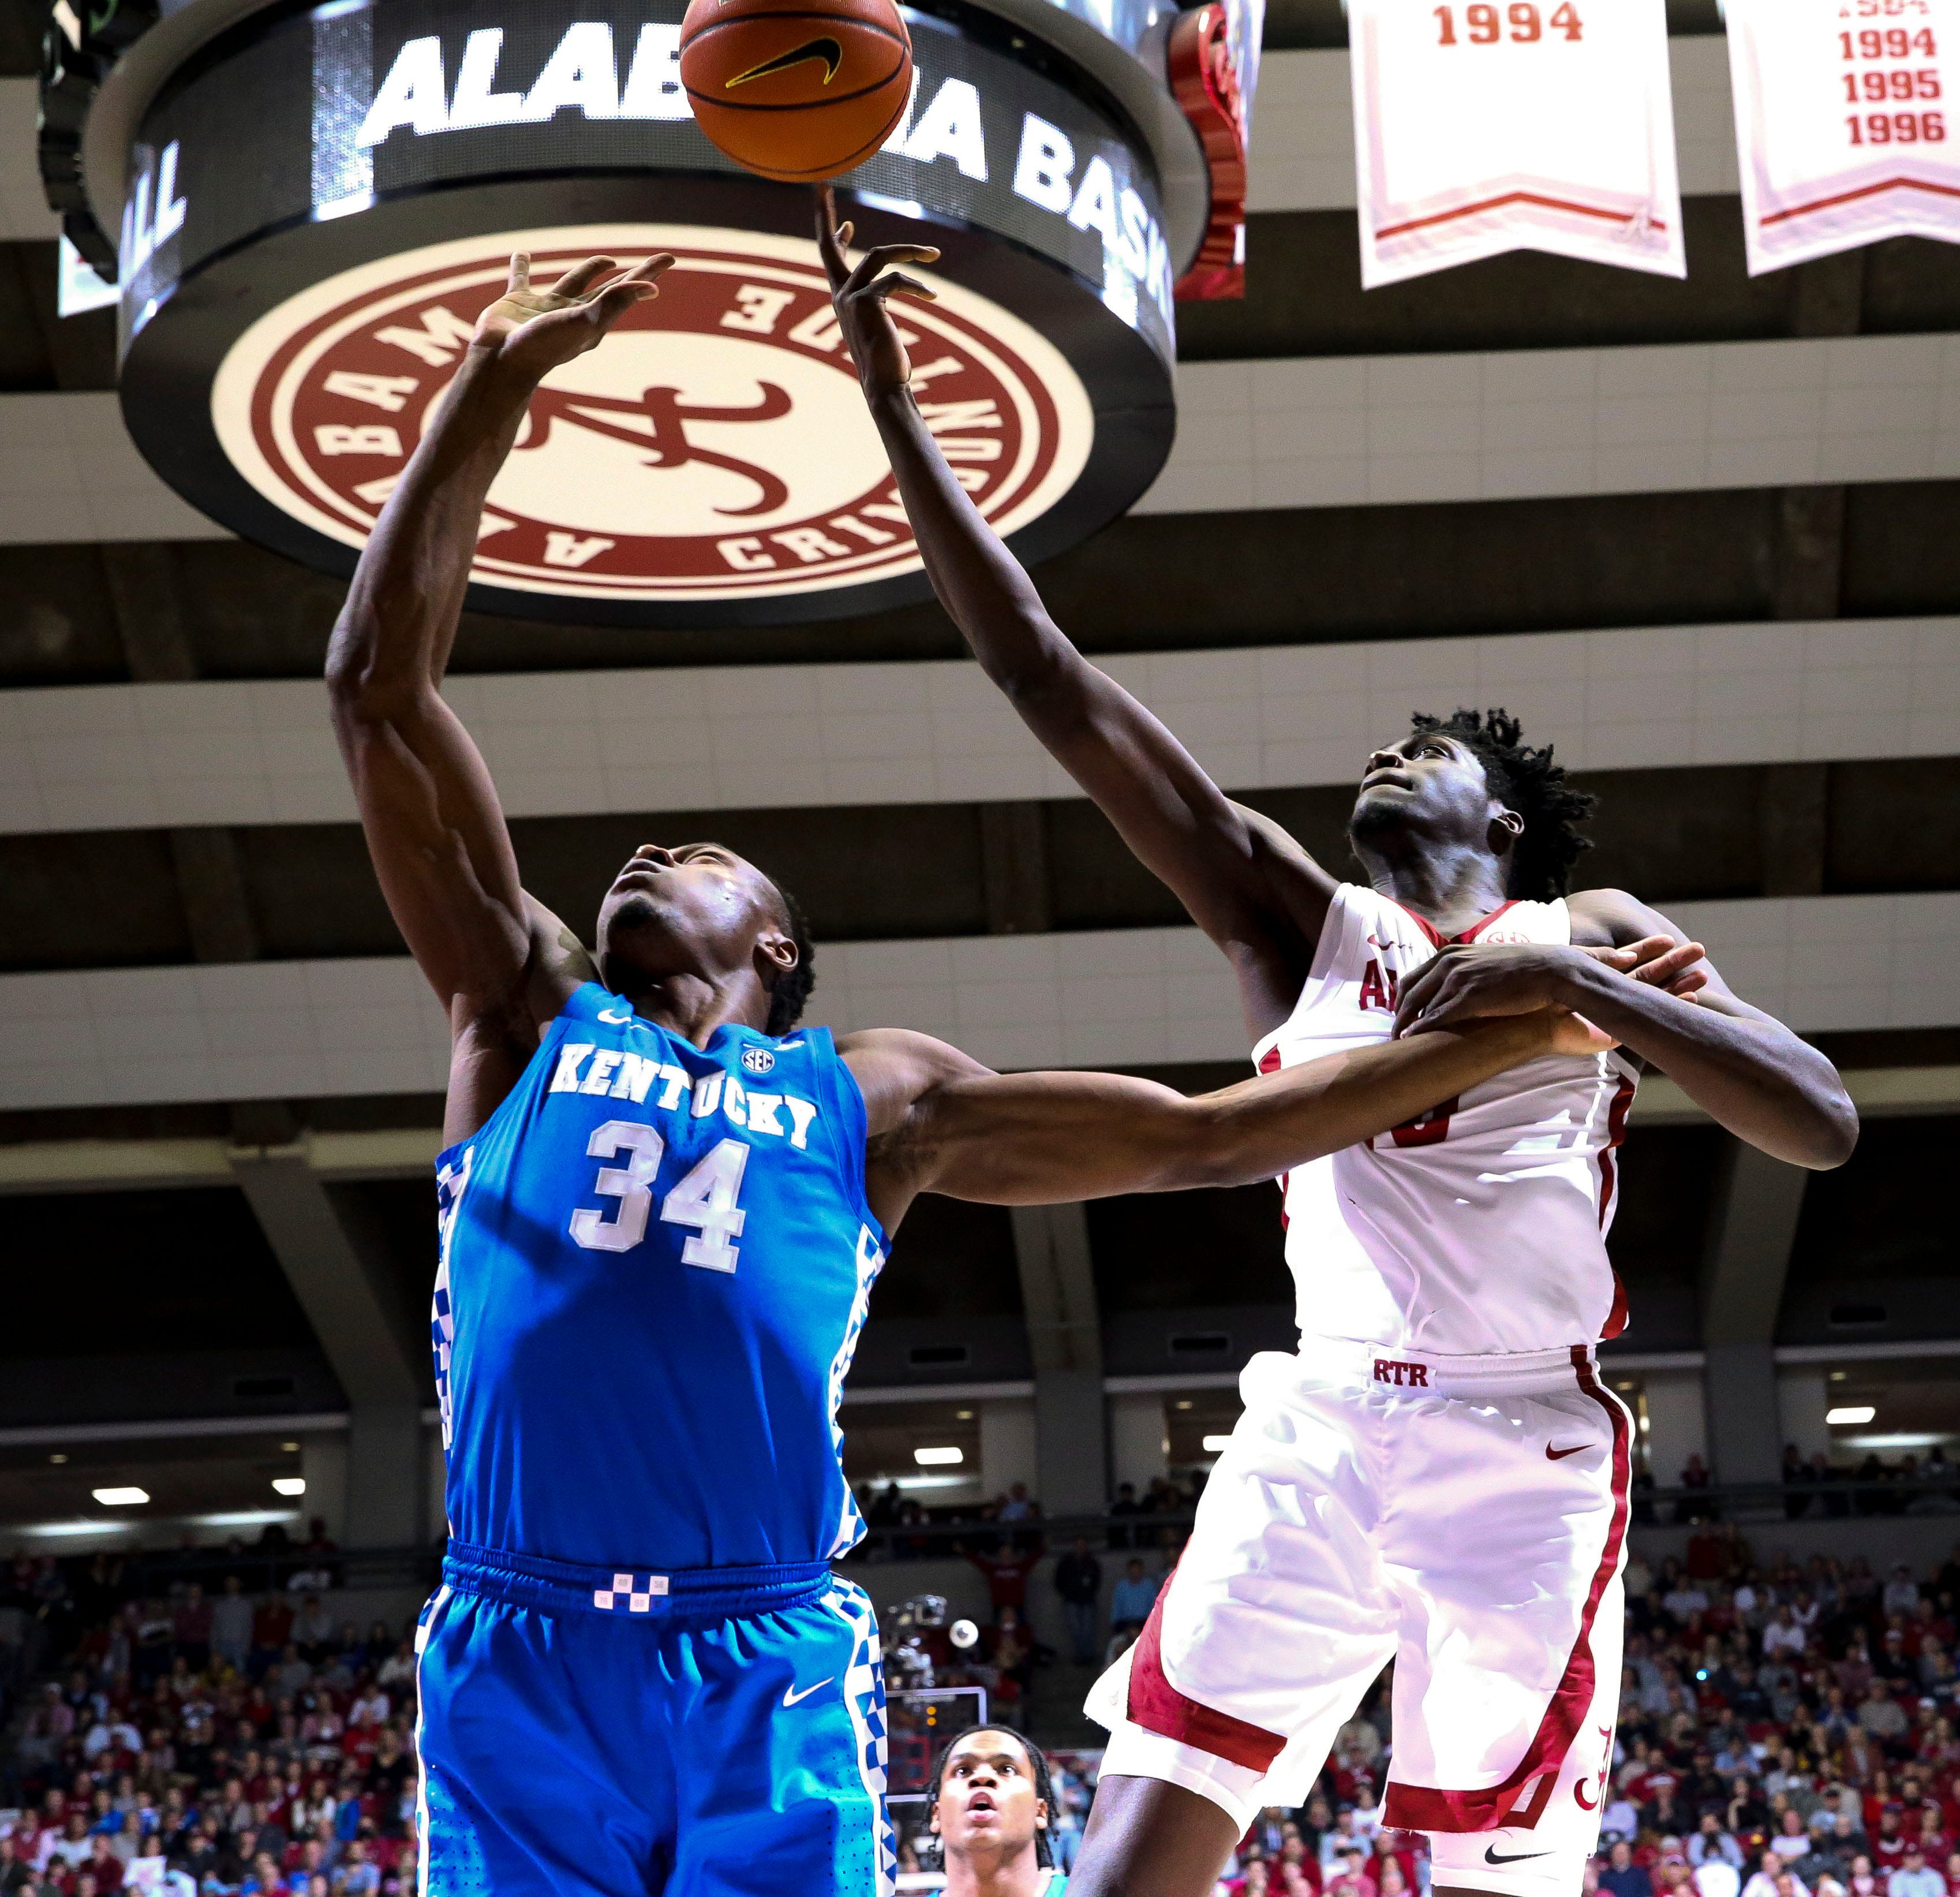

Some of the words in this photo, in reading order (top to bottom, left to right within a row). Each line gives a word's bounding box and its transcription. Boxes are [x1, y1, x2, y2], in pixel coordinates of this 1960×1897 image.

[1431, 1, 1584, 47] 1994
[1838, 27, 1938, 61] 1994
[354, 22, 989, 182] ALABA
[1841, 68, 1942, 103] 1995
[1843, 111, 1947, 145] 1996
[743, 1050, 773, 1072] SEC
[548, 1043, 817, 1150] KENTUCKY
[568, 1119, 750, 1274] 34
[1374, 1358, 1428, 1387] RTR
